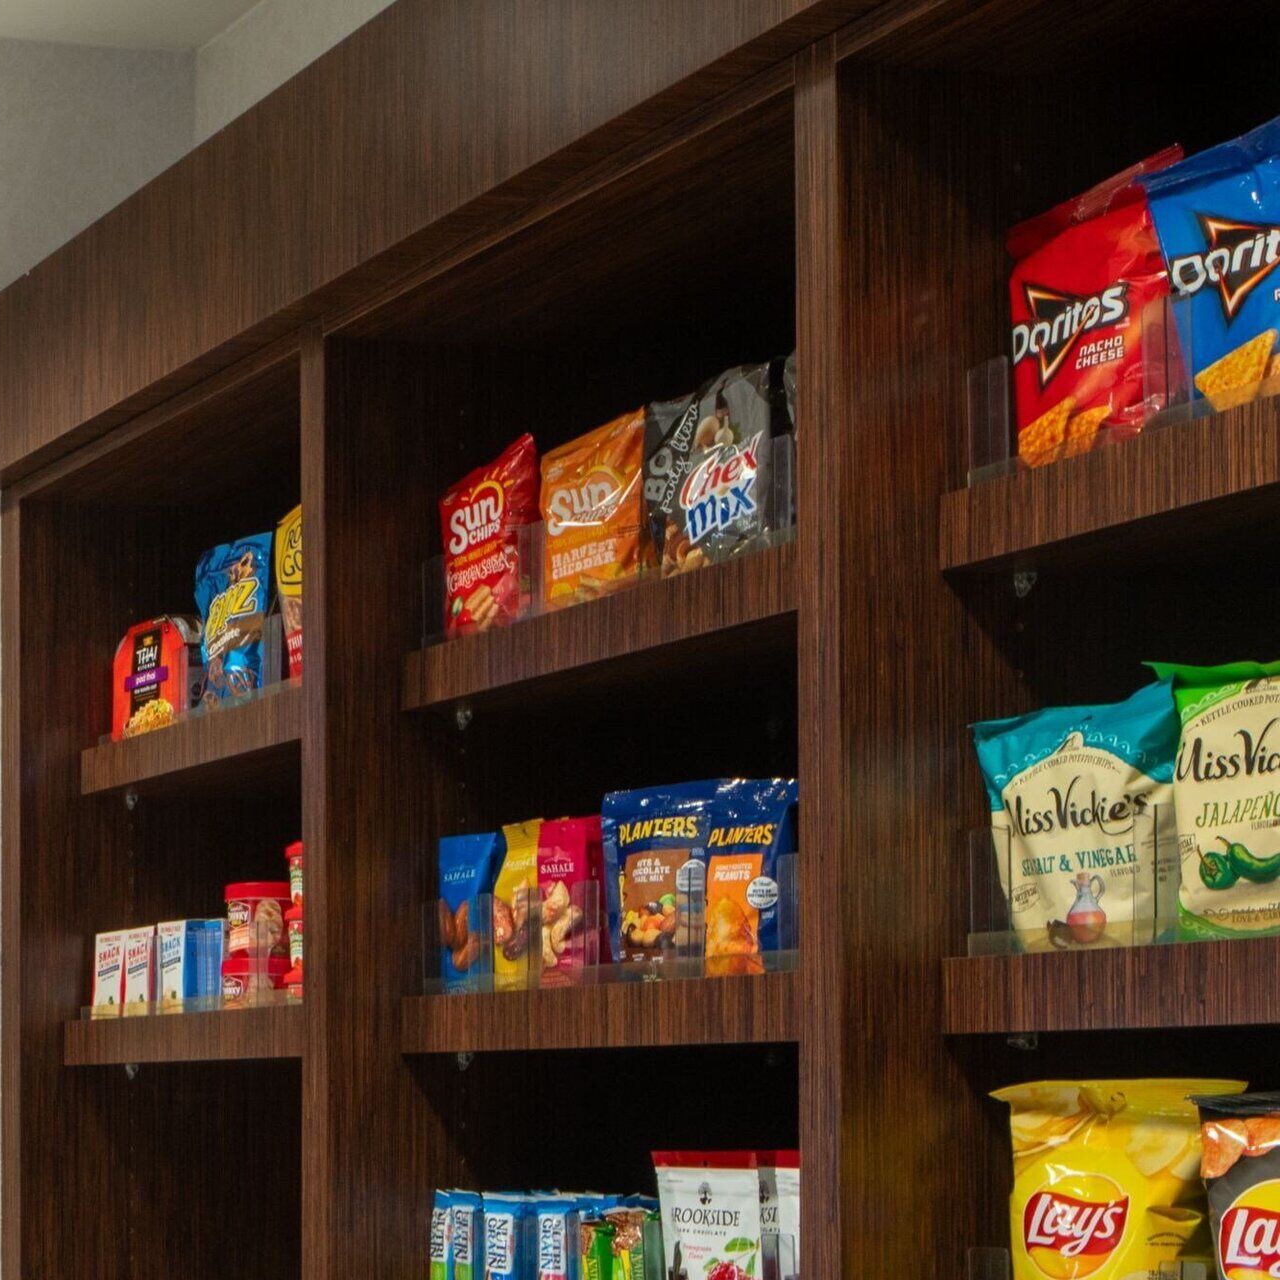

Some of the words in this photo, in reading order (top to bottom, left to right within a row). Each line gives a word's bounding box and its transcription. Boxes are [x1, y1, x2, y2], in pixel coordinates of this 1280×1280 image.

[1013, 285, 1130, 364] Doritos
[1075, 346, 1125, 370] CHEESE
[1079, 335, 1124, 355] NACHO
[680, 432, 763, 508] Chex
[548, 479, 620, 536] Sun
[449, 497, 503, 555] Sun
[467, 518, 501, 544] CHIPS
[552, 538, 617, 567] HARVEST
[552, 551, 616, 580] CHEDDAR
[136, 646, 158, 664] THAI
[1200, 706, 1232, 727] KETTLE
[1232, 694, 1263, 713] COOKED
[619, 816, 699, 848] PLANTERS
[707, 823, 774, 848] PLANTERS
[443, 869, 476, 882] SAHALE
[540, 862, 574, 874] SAHALE
[714, 871, 750, 882] PEANUTS
[1059, 854, 1073, 872] &
[1027, 1193, 1124, 1257] Lay's
[496, 1218, 507, 1271] NUTRI
